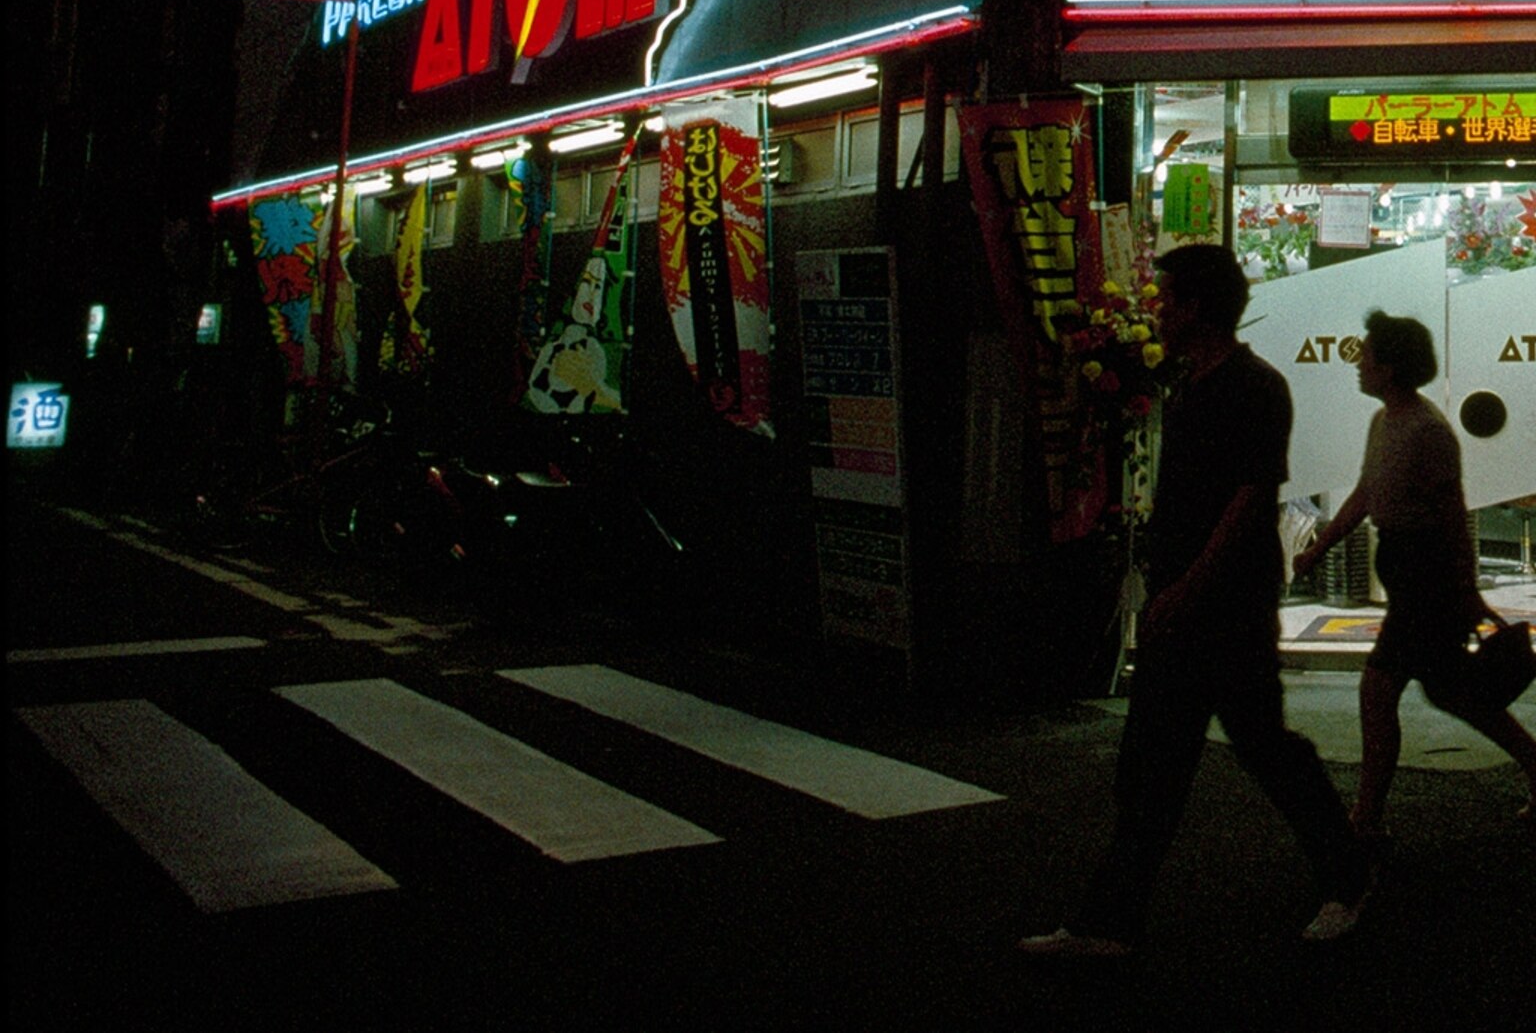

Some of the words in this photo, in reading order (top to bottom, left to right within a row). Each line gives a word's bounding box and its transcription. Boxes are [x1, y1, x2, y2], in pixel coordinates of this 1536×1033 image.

[1363, 94, 1523, 118] パーラーアトム
[1295, 336, 1368, 364] ATO
[11, 388, 63, 435] 酒
